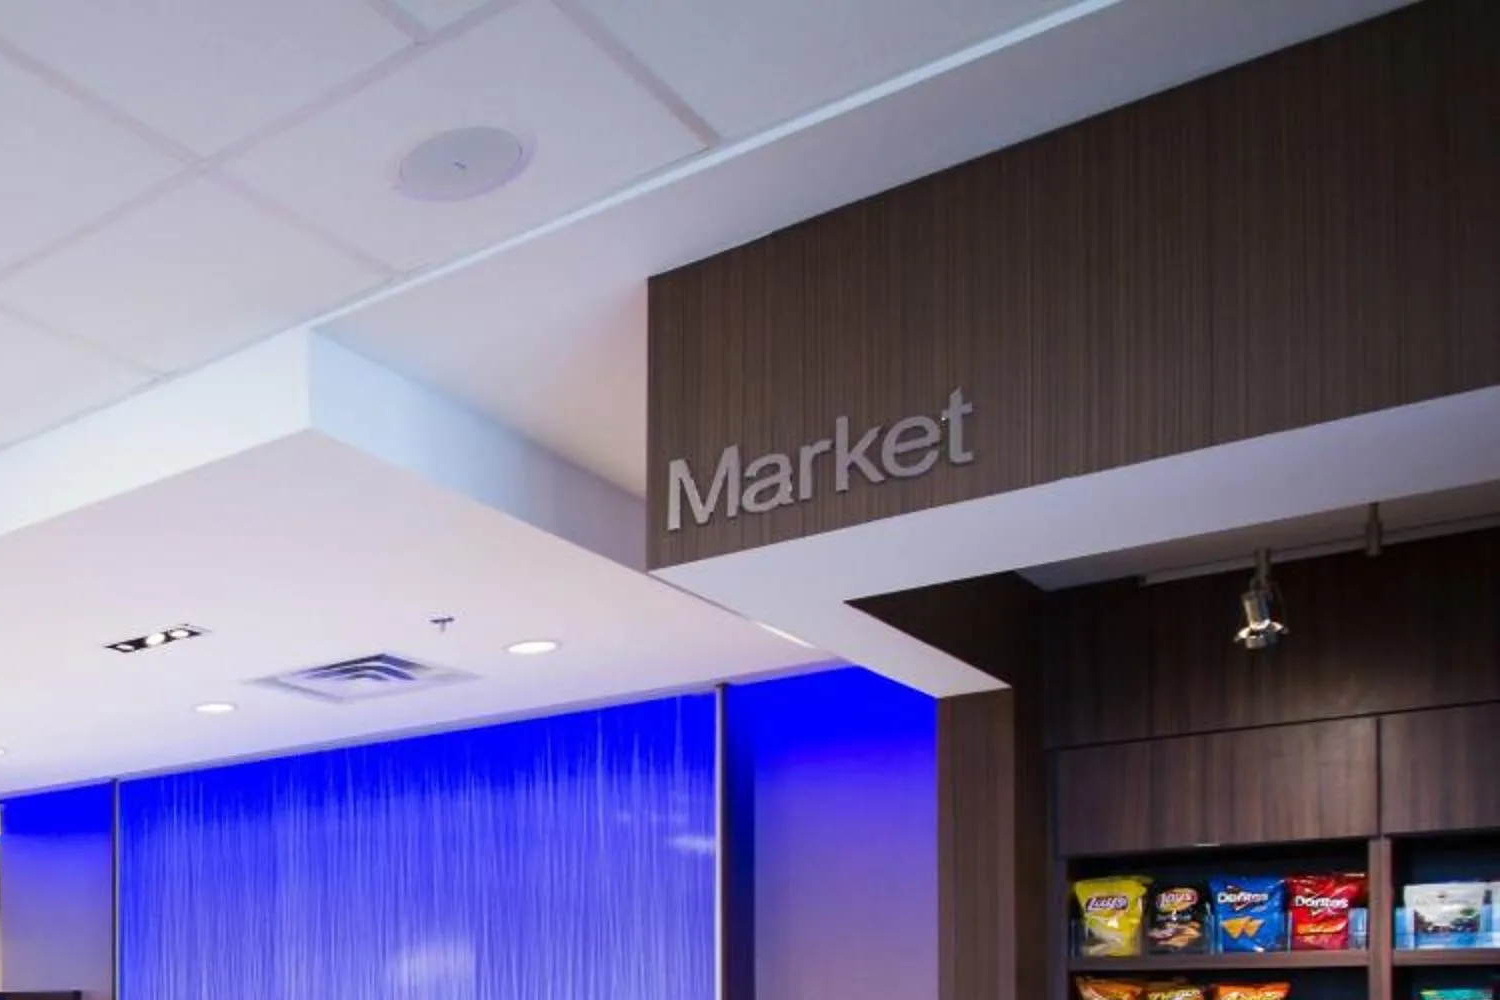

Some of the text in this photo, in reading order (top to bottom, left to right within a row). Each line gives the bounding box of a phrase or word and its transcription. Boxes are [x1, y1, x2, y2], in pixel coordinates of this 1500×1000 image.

[667, 386, 974, 531] Market
[1217, 891, 1269, 904] Doritos
[1295, 895, 1349, 909] Doritos
